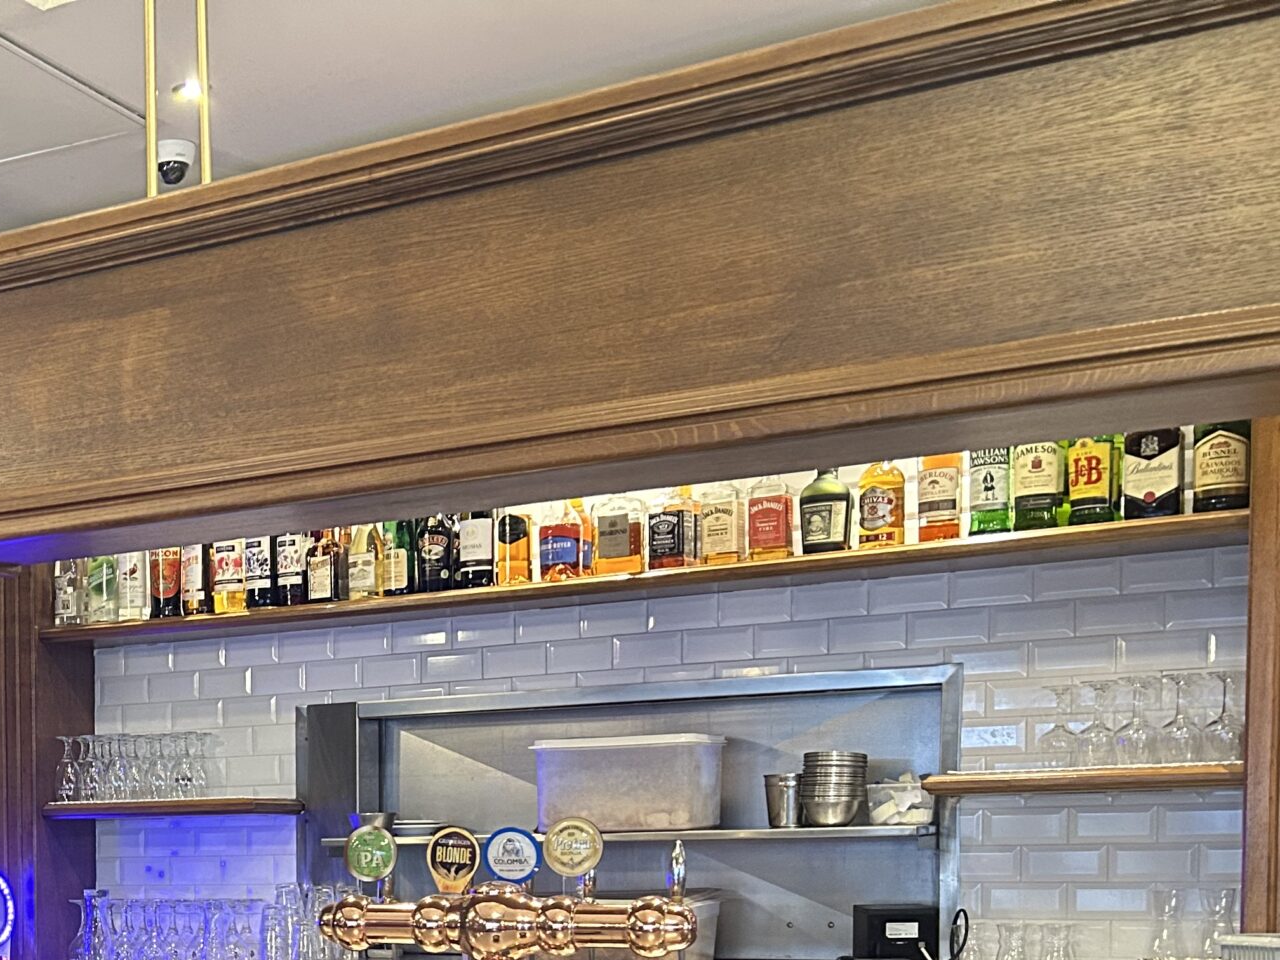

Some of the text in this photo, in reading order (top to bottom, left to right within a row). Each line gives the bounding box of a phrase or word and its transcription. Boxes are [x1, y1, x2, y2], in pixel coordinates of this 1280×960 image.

[971, 447, 1008, 459] WILLIAM
[1016, 445, 1057, 460] JAMESON
[1070, 455, 1102, 488] J&B
[702, 506, 733, 520] JACK DANIEL'S
[750, 500, 783, 514] JACK DANIEL'S
[650, 516, 660, 526] JACK
[879, 533, 886, 541] 12
[150, 550, 179, 560] PICON
[355, 851, 386, 868] IPA
[436, 845, 473, 865] BLONDE
[494, 858, 529, 866] COLOMBA
